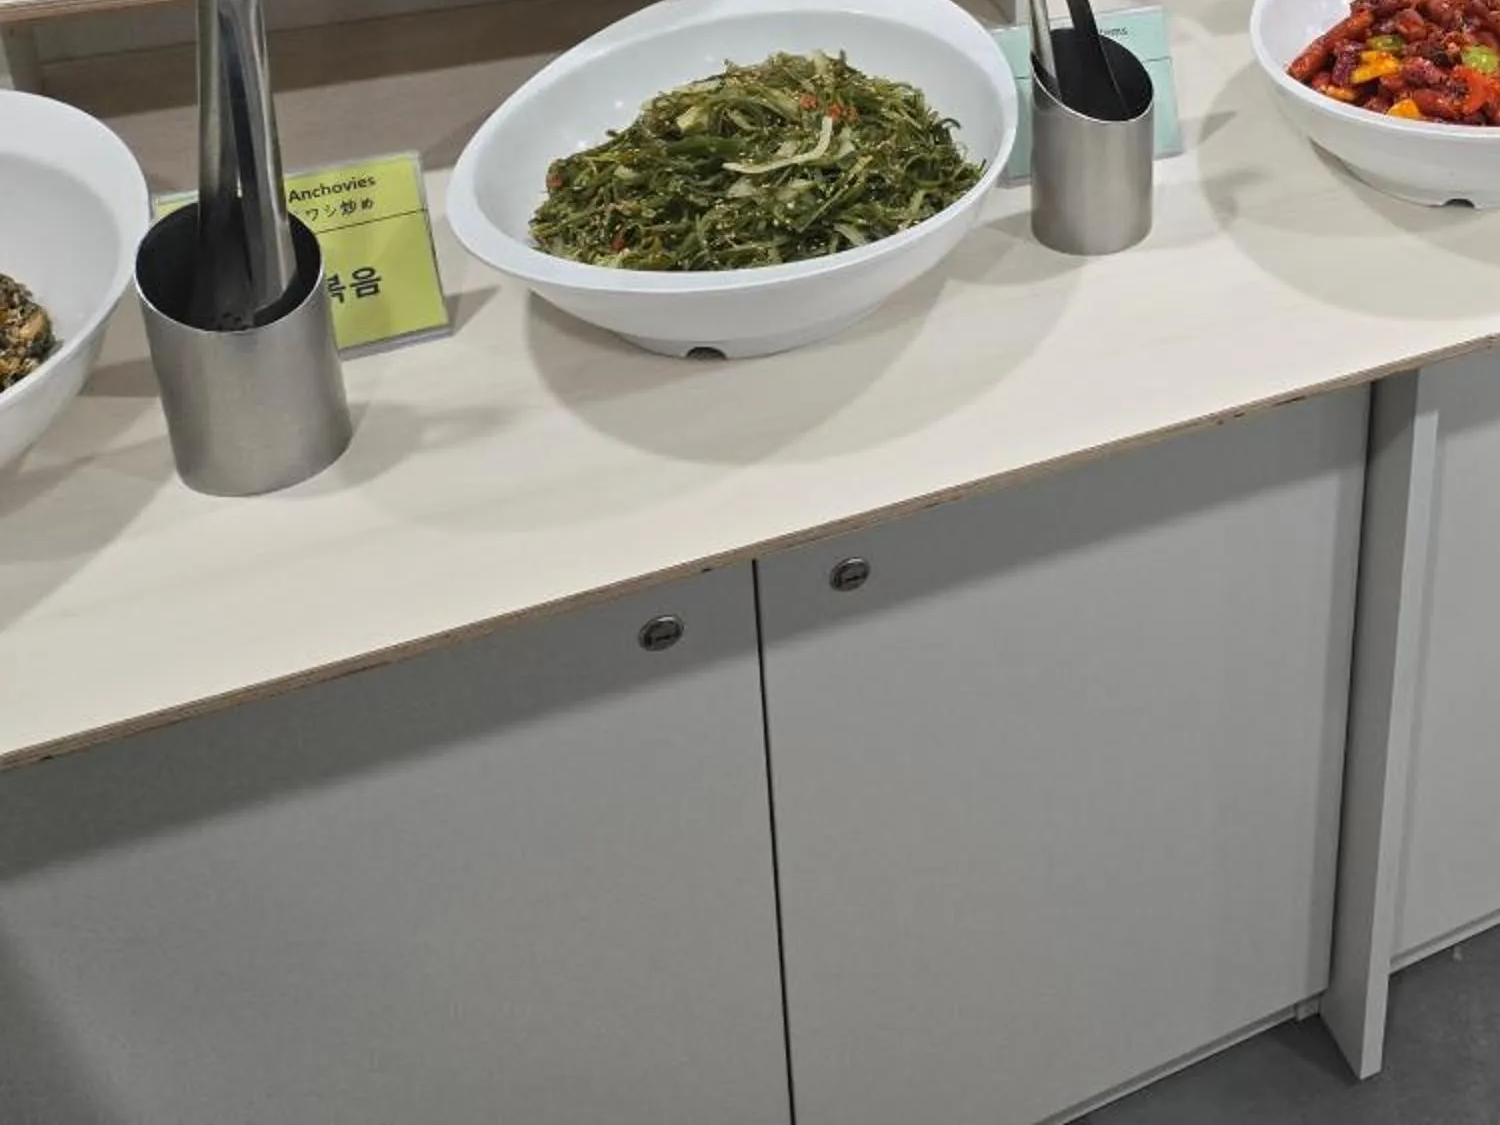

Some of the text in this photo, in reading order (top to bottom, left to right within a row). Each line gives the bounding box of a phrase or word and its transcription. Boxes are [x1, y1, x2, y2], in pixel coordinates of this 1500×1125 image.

[288, 173, 376, 203] Anchovies
[296, 197, 375, 223] ワシ炒め
